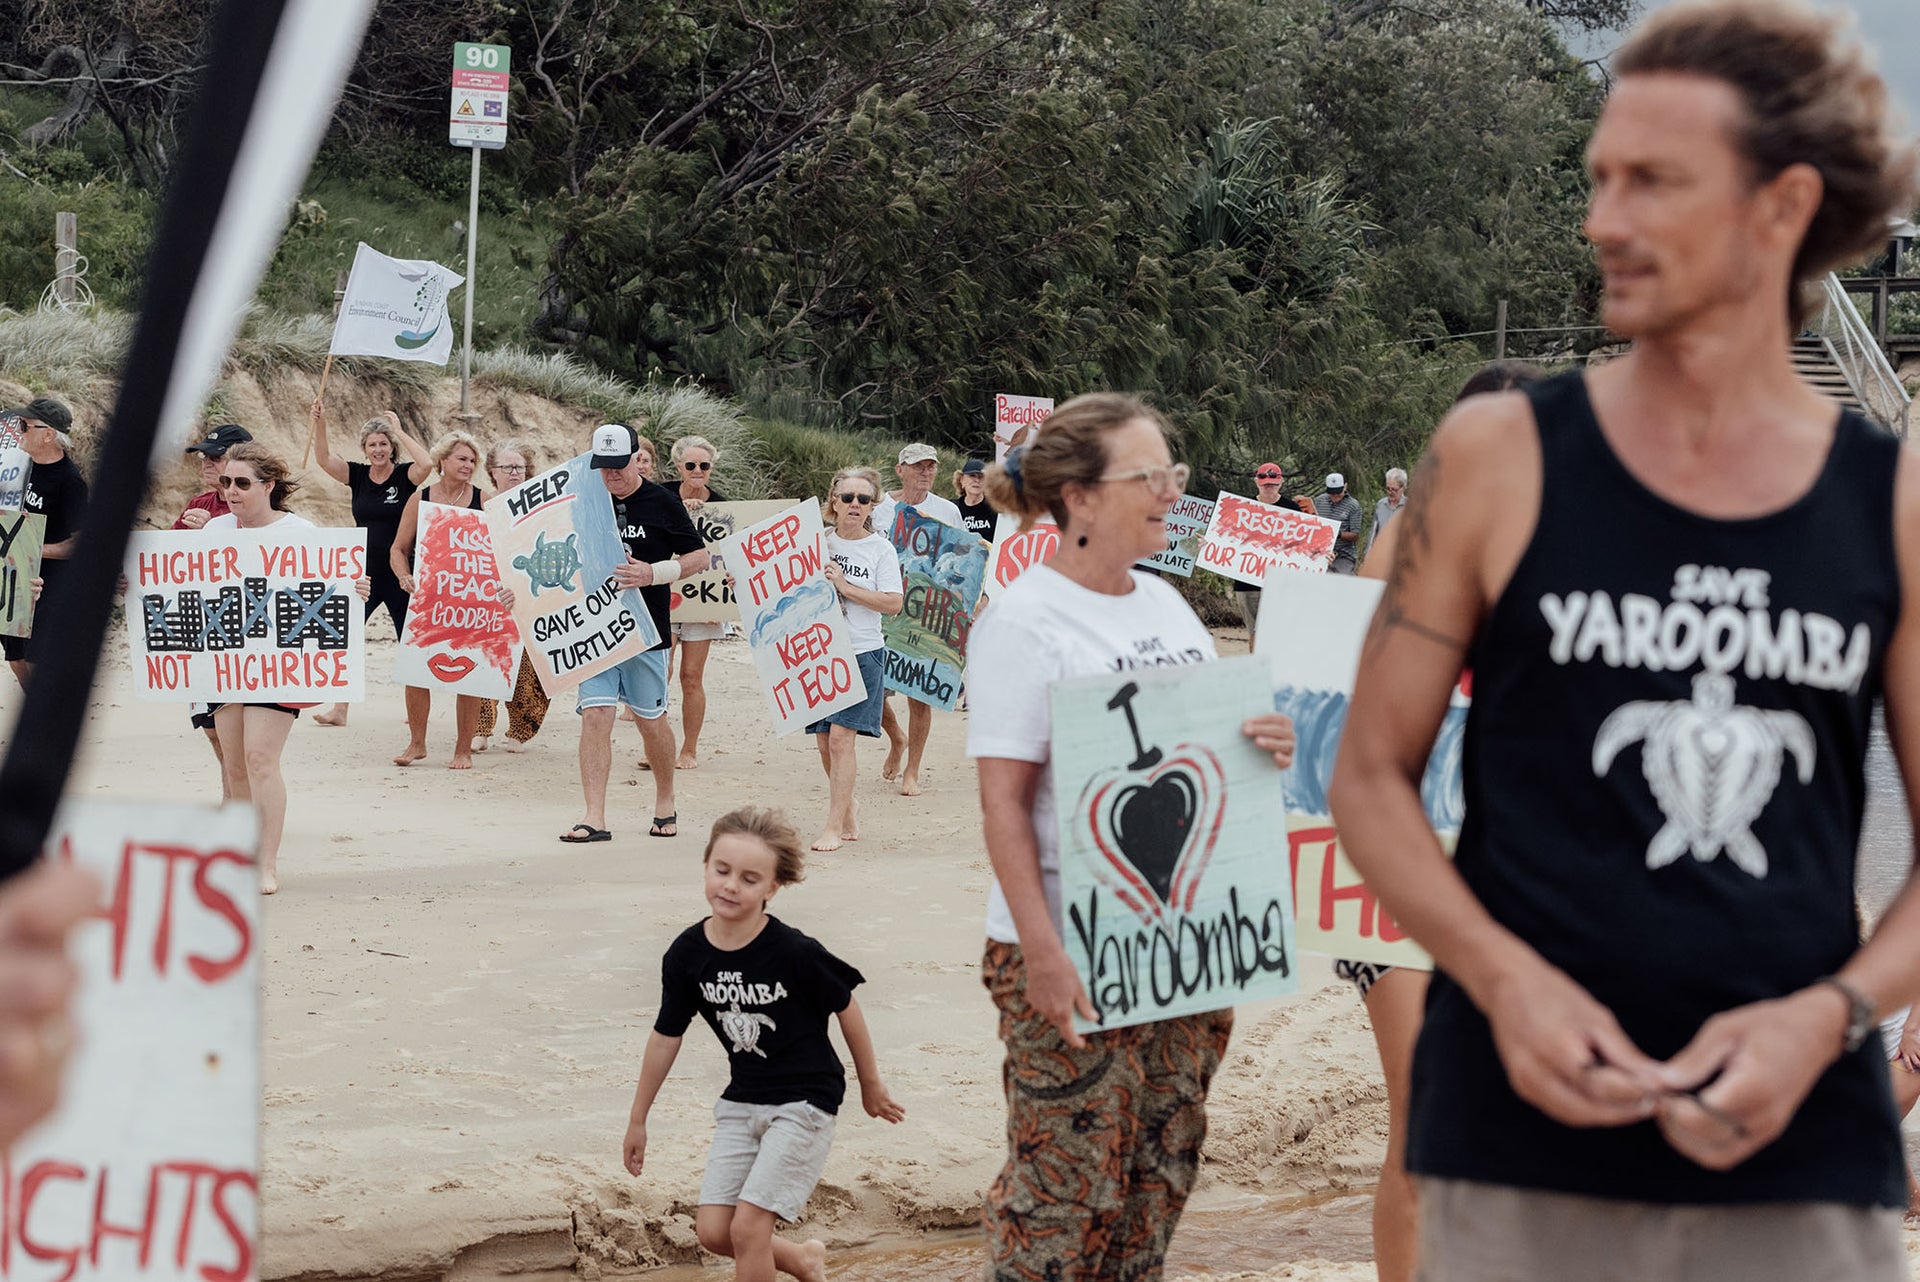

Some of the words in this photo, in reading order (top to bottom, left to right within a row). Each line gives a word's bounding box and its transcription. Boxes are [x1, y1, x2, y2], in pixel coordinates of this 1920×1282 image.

[466, 46, 498, 69] 90
[388, 310, 421, 326] Council
[0, 467, 20, 481] RD
[507, 470, 570, 517] HELP
[741, 514, 801, 568] KEEP
[1165, 522, 1196, 537] OAST
[1236, 508, 1321, 544] RESPECT
[139, 546, 243, 587] HIGHER
[259, 545, 366, 580] VALUES
[451, 552, 493, 576] THE
[748, 569, 768, 606] IT
[774, 532, 822, 594] LOW
[834, 554, 849, 563] SAVE
[1164, 554, 1192, 571] LATE
[1204, 542, 1236, 567] OUR
[435, 570, 501, 601] PEAC
[1671, 563, 1772, 607] SAVE
[431, 601, 505, 633] GOODBYE
[533, 605, 585, 642] SAVE
[585, 575, 622, 616] OUR
[547, 609, 636, 675] TURTLES
[776, 623, 833, 671] KEEP
[907, 630, 922, 646] IN
[146, 654, 193, 689] NOT
[216, 651, 349, 692] HIGHRISE
[772, 678, 795, 720] IT
[797, 657, 851, 710] ECO
[1107, 681, 1163, 771] I
[716, 970, 744, 984] SAVE
